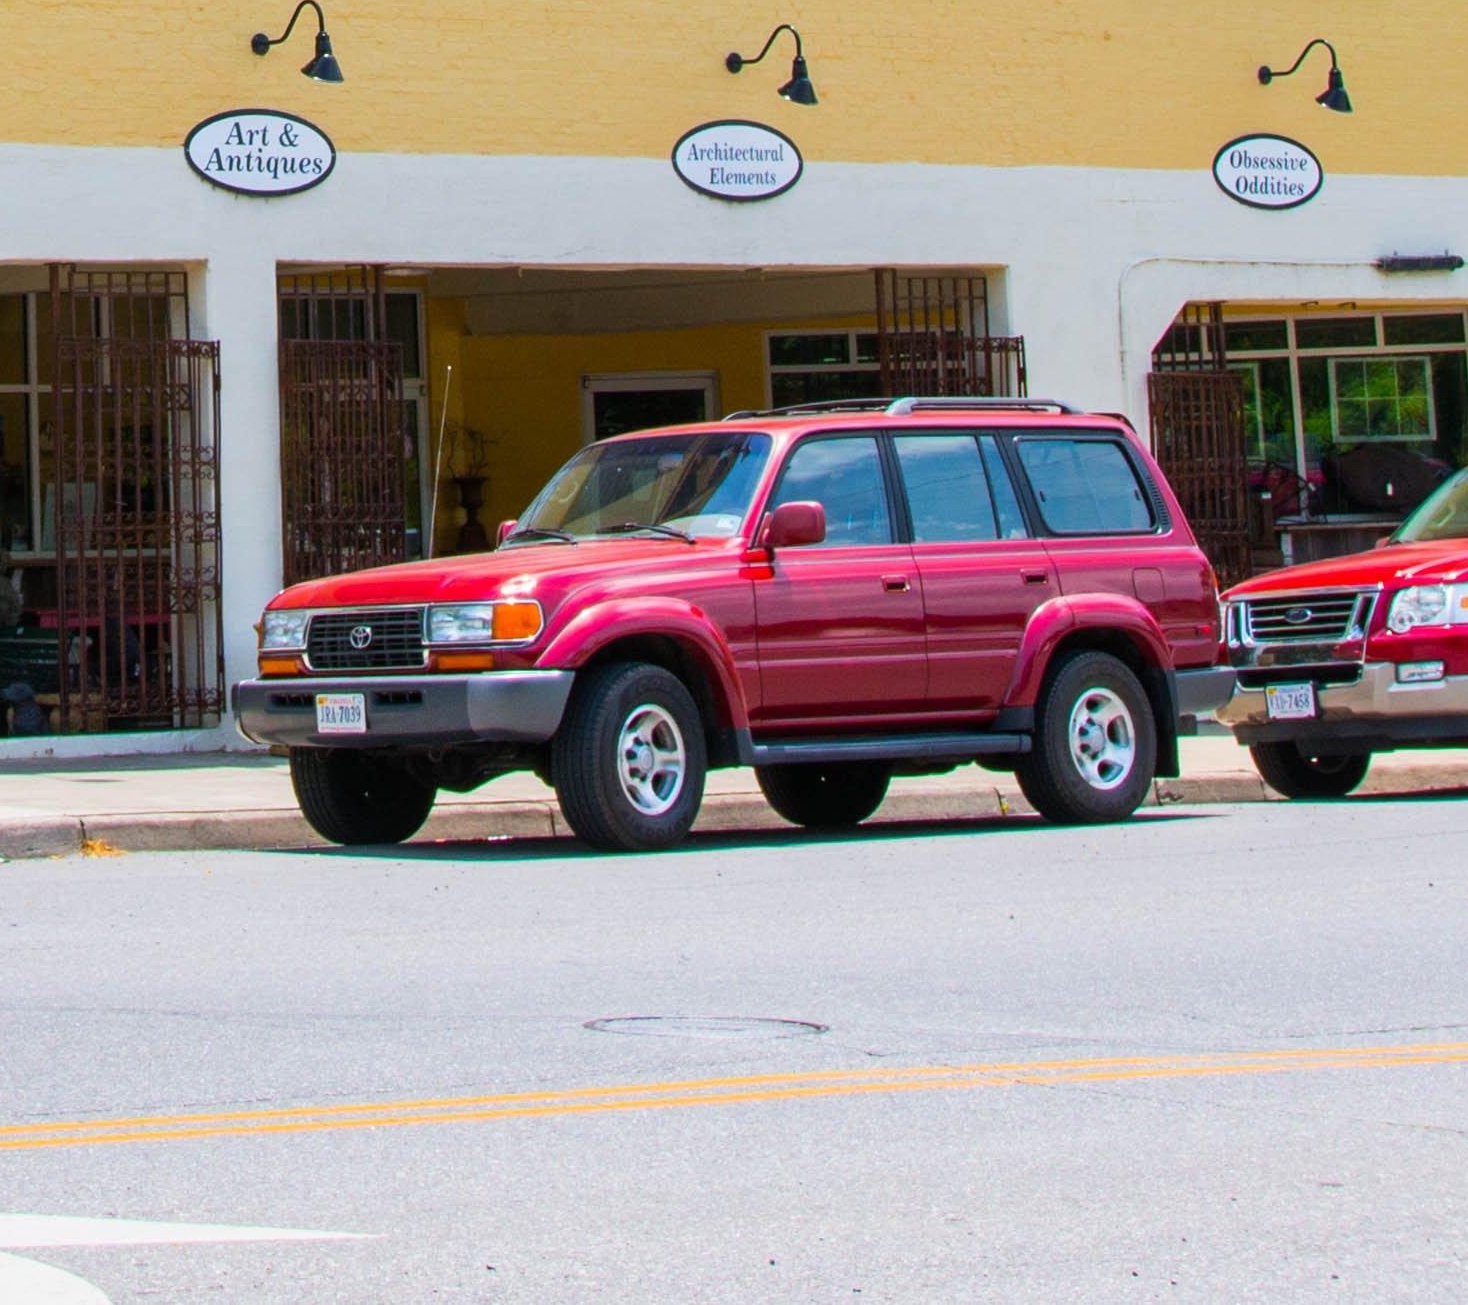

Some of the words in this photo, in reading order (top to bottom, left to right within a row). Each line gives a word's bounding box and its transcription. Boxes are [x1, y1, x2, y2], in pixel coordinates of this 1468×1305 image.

[224, 121, 269, 148] Art
[278, 122, 300, 148] &
[204, 147, 324, 177] Antiques
[687, 142, 785, 166] Architectural
[1229, 148, 1309, 174] Obsessive
[709, 166, 778, 187] Elements
[1234, 174, 1305, 198] Oddities
